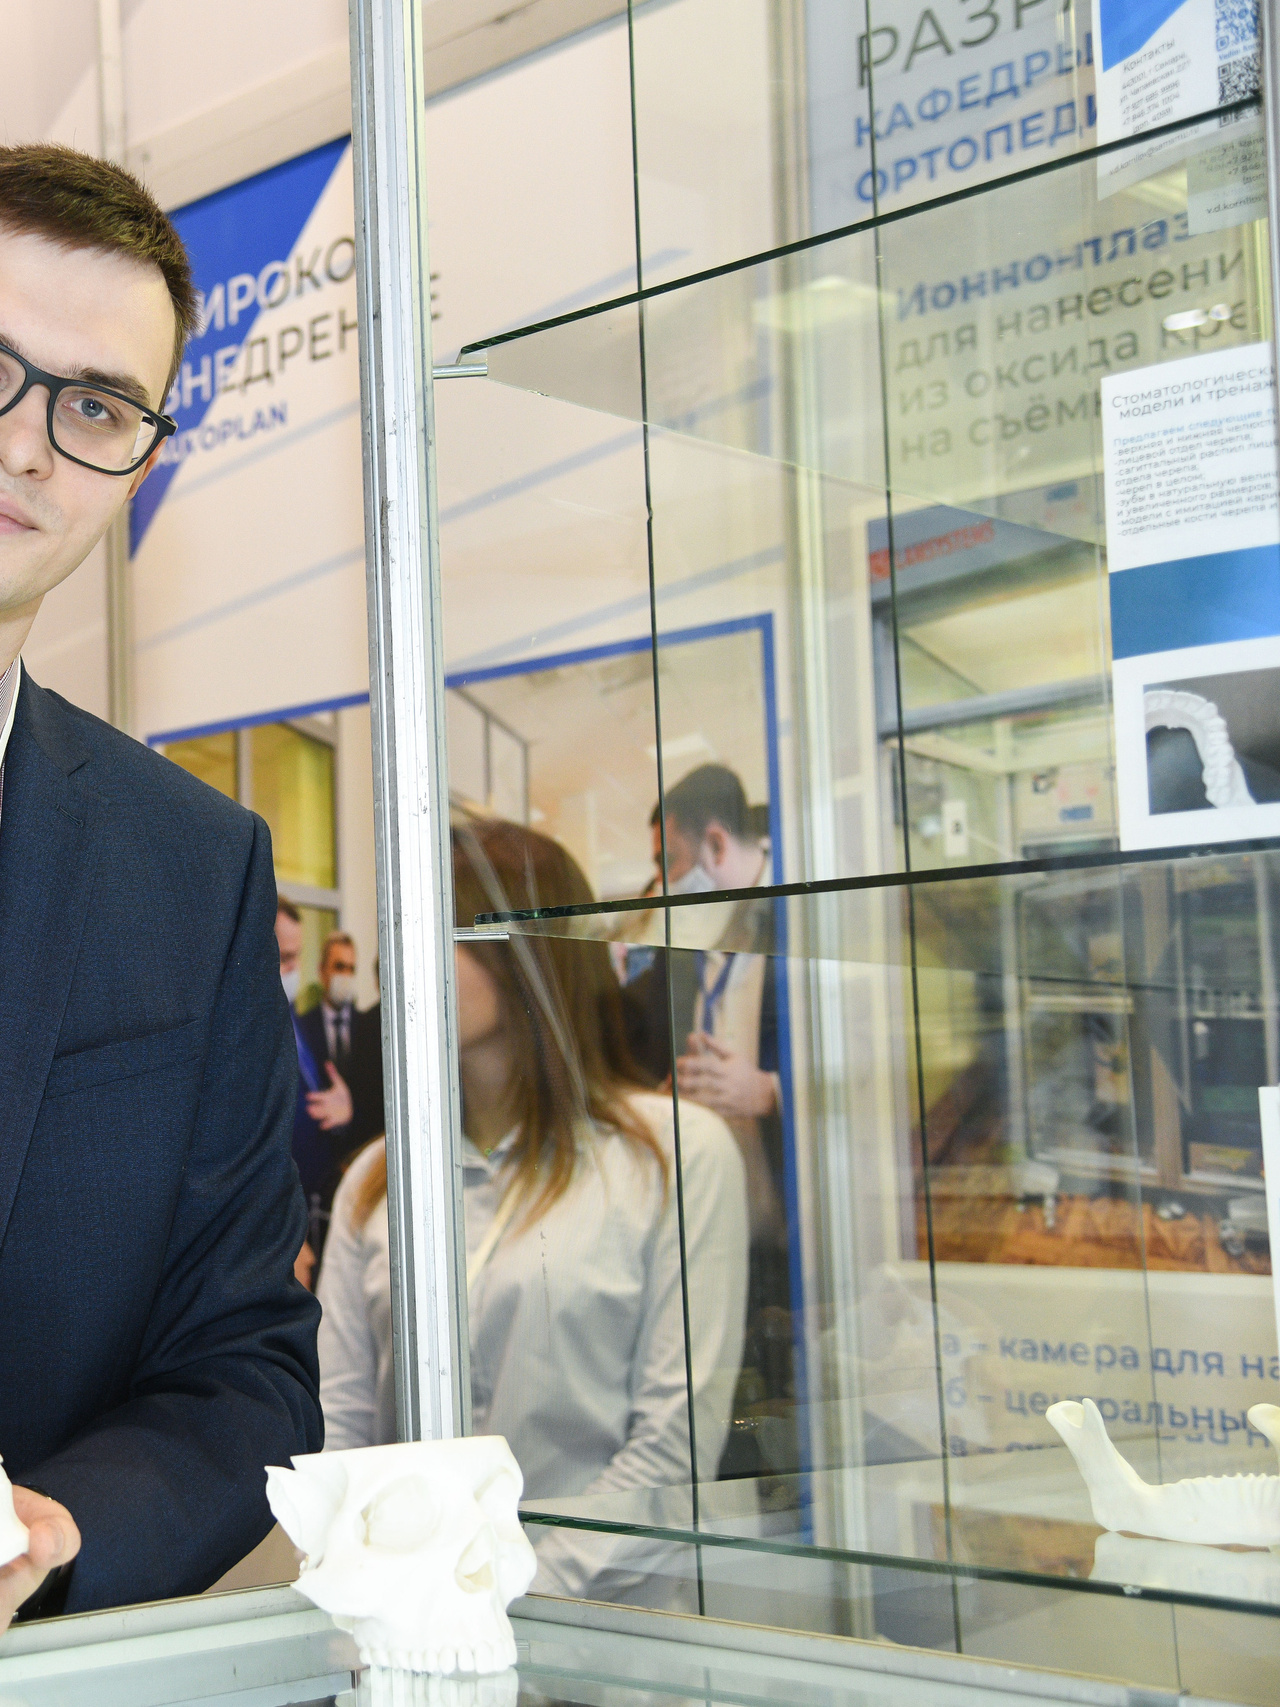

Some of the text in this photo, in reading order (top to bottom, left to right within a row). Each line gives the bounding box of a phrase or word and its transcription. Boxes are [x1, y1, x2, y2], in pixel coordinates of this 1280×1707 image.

[855, 0, 1071, 90] РАЗР
[1122, 37, 1176, 73] Контакты
[894, 322, 978, 374] для
[898, 379, 950, 418] из
[964, 328, 1140, 402] оксида
[1119, 396, 1184, 421] модели
[1191, 392, 1202, 404] и
[901, 428, 953, 466] на
[1113, 425, 1185, 448] Предлагаем
[999, 1336, 1141, 1373] камера
[1152, 1347, 1224, 1378] для
[944, 1376, 968, 1409] б
